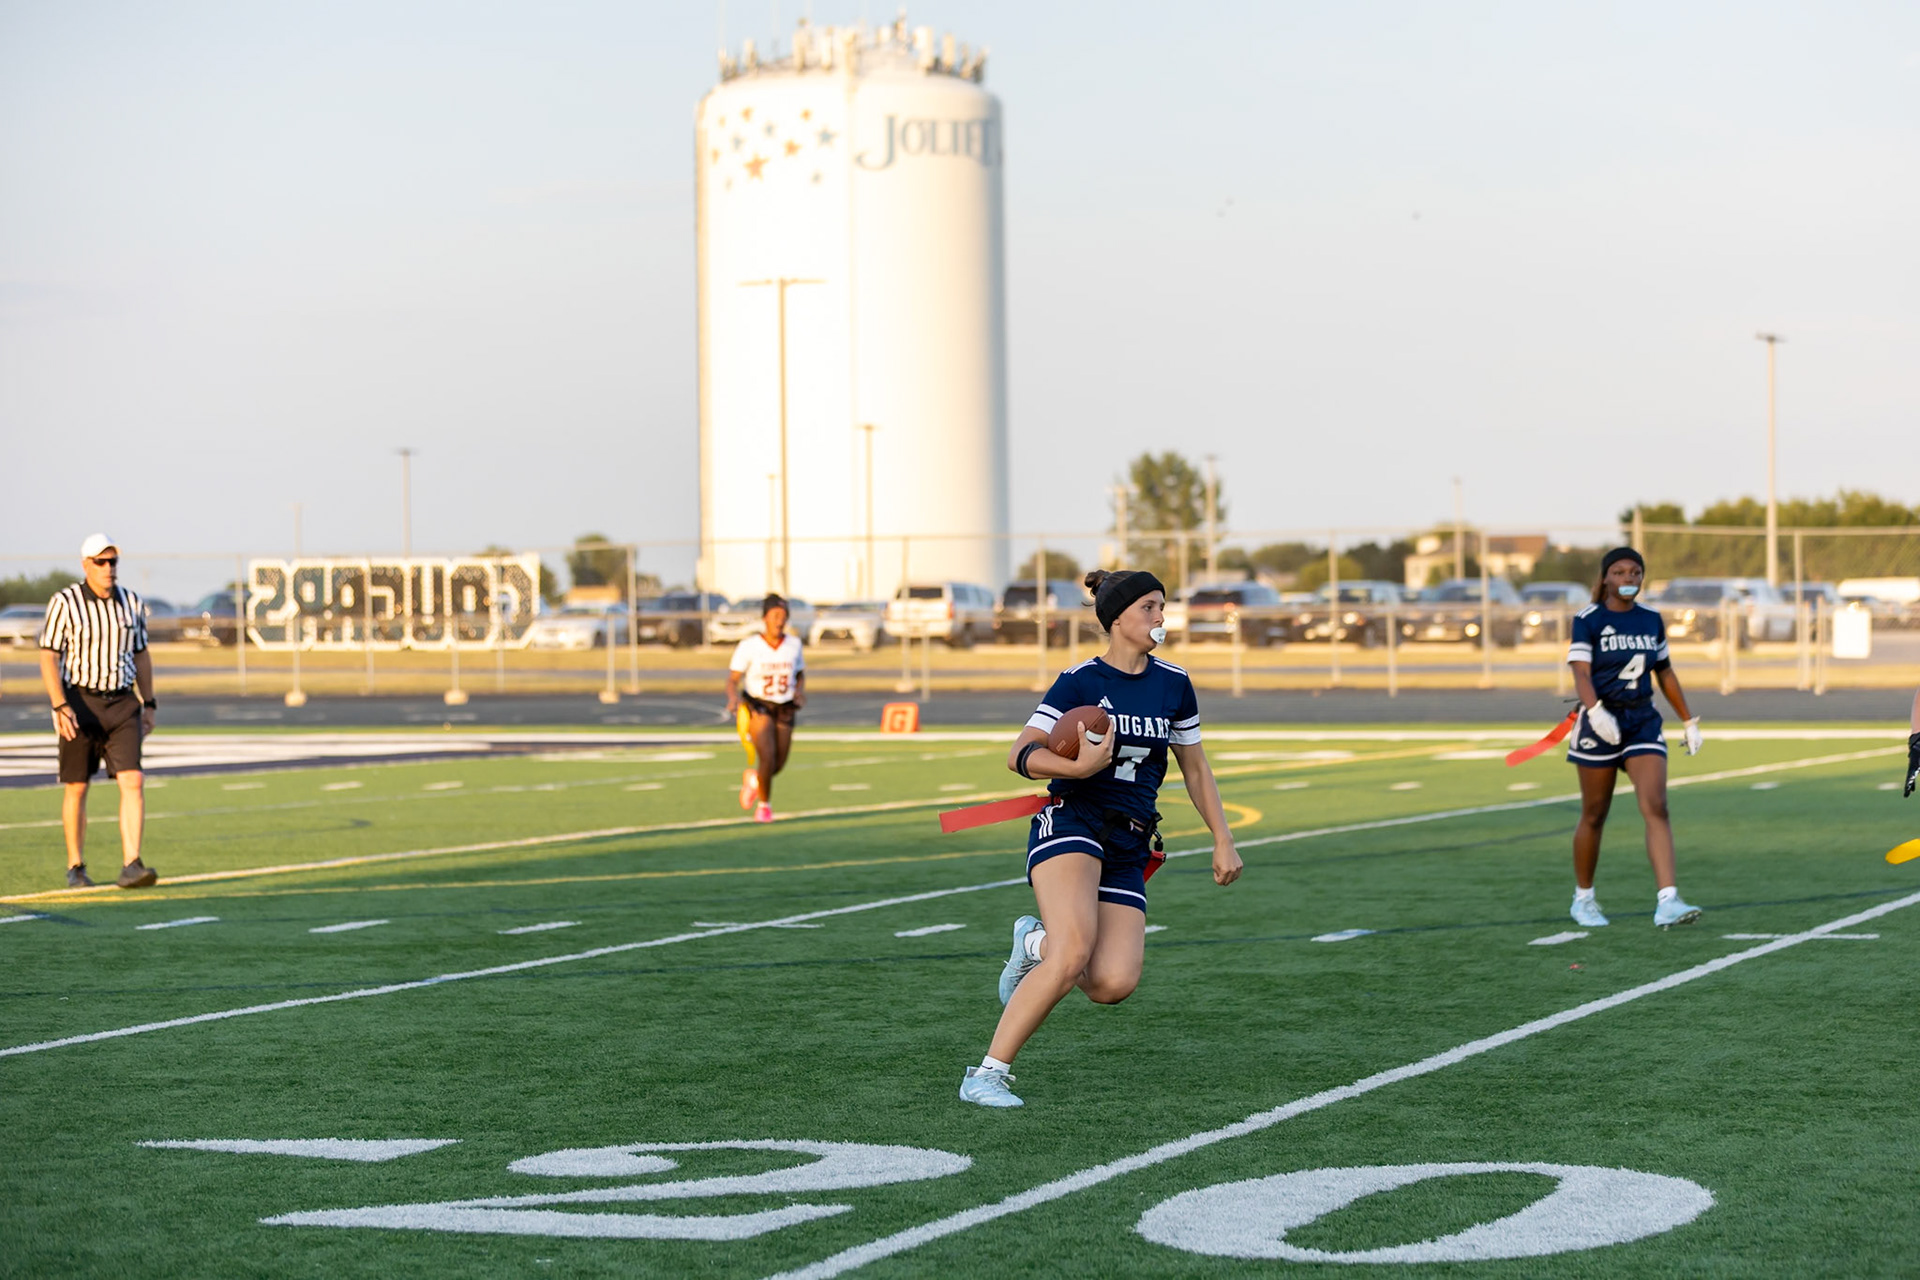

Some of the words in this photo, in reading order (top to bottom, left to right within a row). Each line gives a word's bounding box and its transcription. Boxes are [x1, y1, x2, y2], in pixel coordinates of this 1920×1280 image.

[1600, 634, 1658, 652] COUGARS
[1618, 653, 1646, 690] 4
[890, 710, 908, 732] G
[1108, 713, 1171, 739] OUGARS
[1114, 745, 1151, 783] 7
